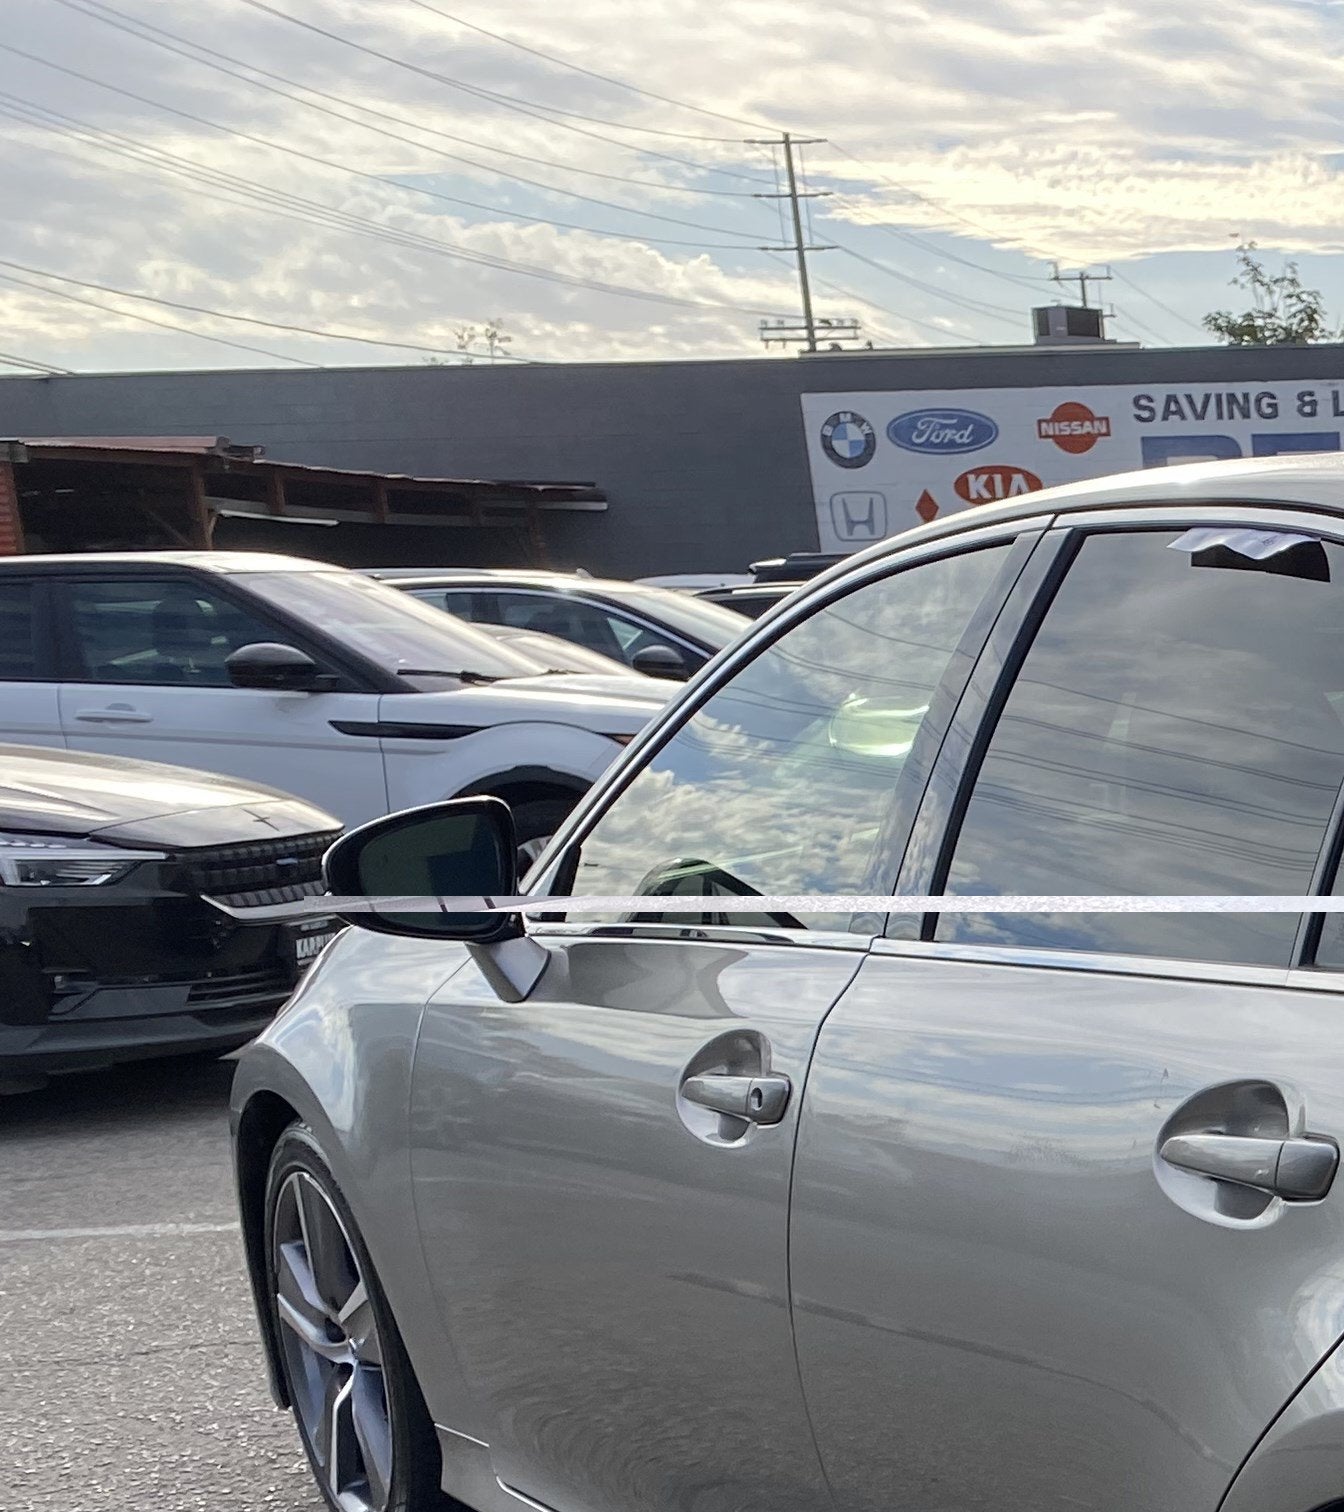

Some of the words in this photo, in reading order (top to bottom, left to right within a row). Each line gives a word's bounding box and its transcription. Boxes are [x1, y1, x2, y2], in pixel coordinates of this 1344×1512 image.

[1133, 391, 1280, 423] SAVING
[1297, 390, 1318, 417] &
[911, 416, 974, 444] Ford
[1041, 420, 1108, 436] NISSAN
[968, 472, 1031, 499] KIA
